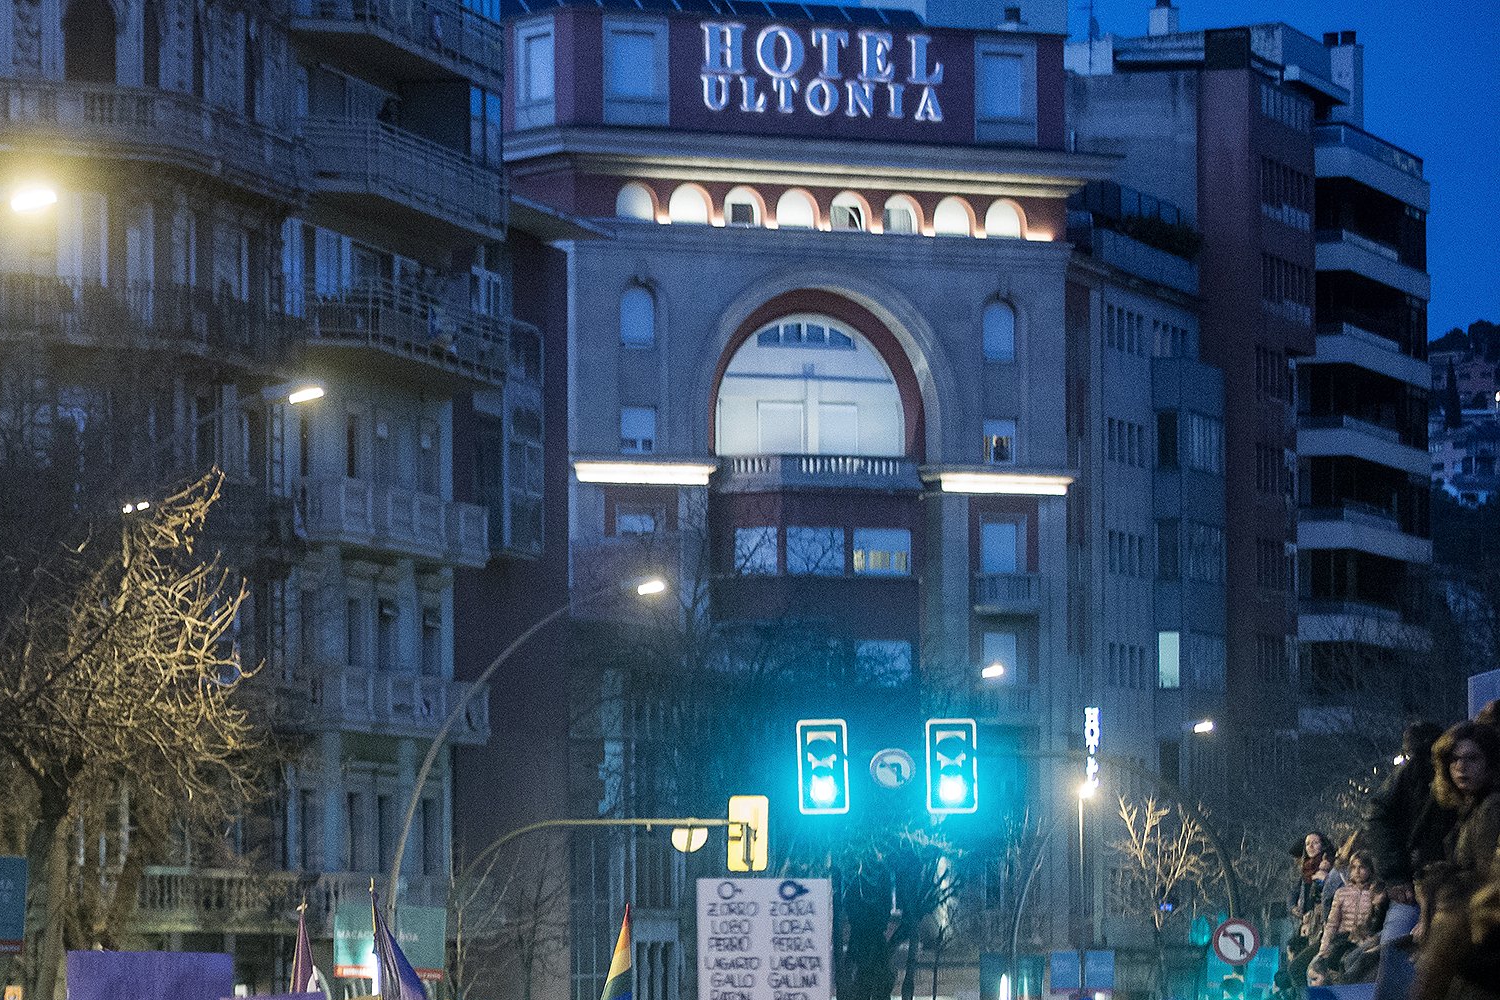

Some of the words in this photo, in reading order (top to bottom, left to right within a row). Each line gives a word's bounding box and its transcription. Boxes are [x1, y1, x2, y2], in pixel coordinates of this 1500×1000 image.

[701, 22, 944, 84] HOTEL
[701, 75, 943, 121] ULTONIA
[706, 901, 759, 917] ZORRO
[710, 919, 751, 935] LOBO
[772, 919, 816, 935] LOBA
[707, 936, 751, 952] PERRO
[772, 936, 816, 951] PERRA
[704, 955, 760, 971] LAGARTO
[710, 973, 755, 989] GALLO
[767, 973, 819, 989] GALLINA
